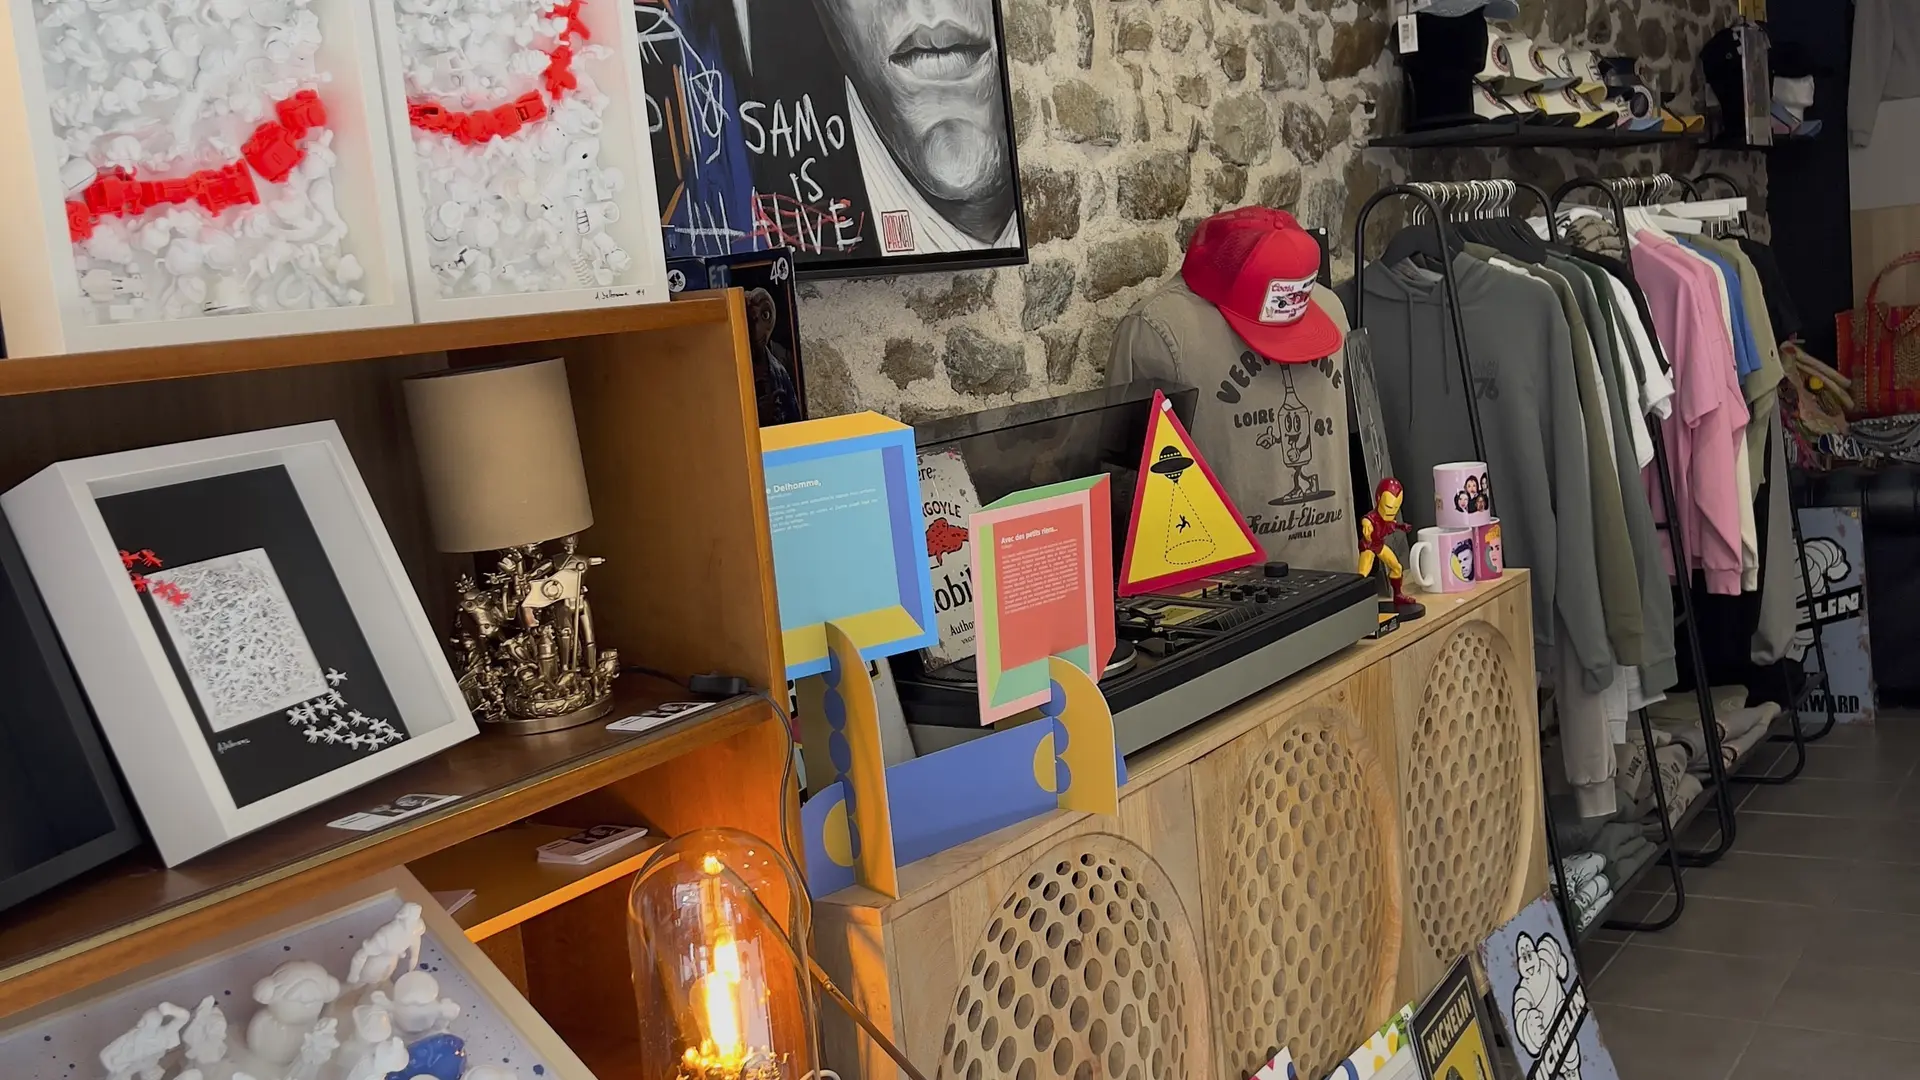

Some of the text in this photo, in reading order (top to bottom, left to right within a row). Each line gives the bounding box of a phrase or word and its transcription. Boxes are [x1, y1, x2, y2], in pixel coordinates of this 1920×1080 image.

[739, 93, 845, 158] SAMO
[789, 157, 824, 203] IS
[1234, 408, 1275, 429] LOIRE
[1314, 417, 1334, 437] 42
[773, 480, 822, 493] Delhomme,
[1797, 592, 1860, 621] ELIN
[1427, 989, 1472, 1065] MICHELIN
[1534, 985, 1588, 1080] ICHELIN
